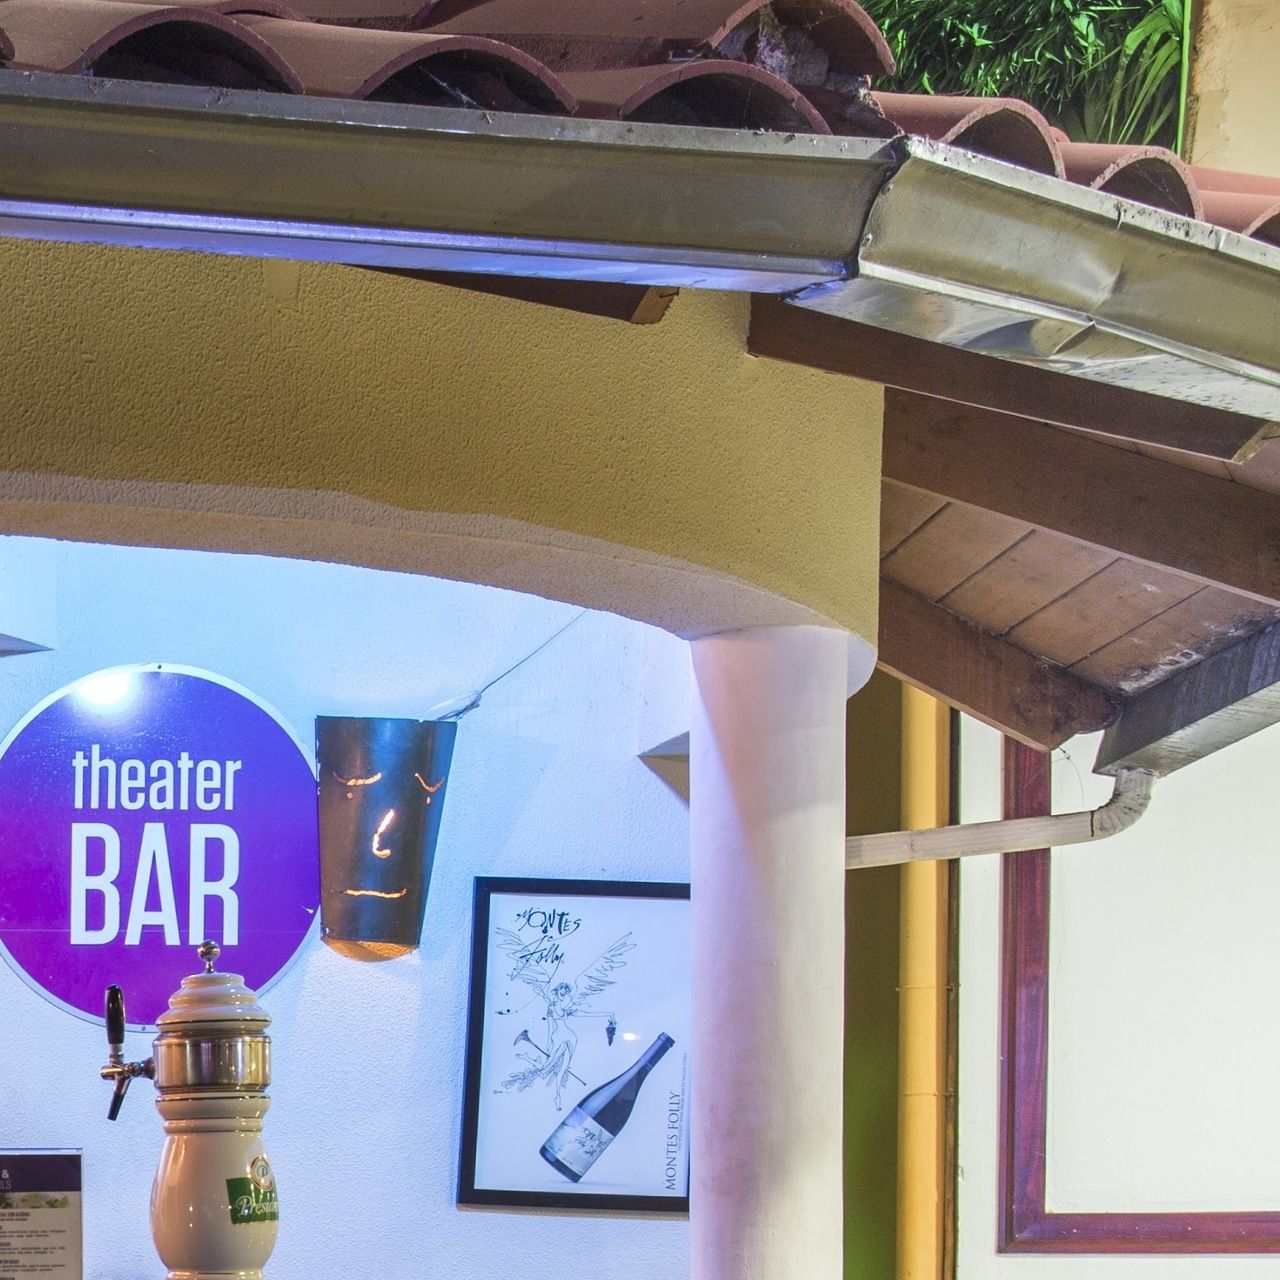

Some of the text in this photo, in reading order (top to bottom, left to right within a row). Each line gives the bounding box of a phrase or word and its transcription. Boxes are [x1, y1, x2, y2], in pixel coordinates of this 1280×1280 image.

[71, 744, 242, 811] theater
[70, 822, 240, 946] BAR
[1, 1168, 10, 1179] &
[665, 1091, 681, 1191] MONTES FOLLY
